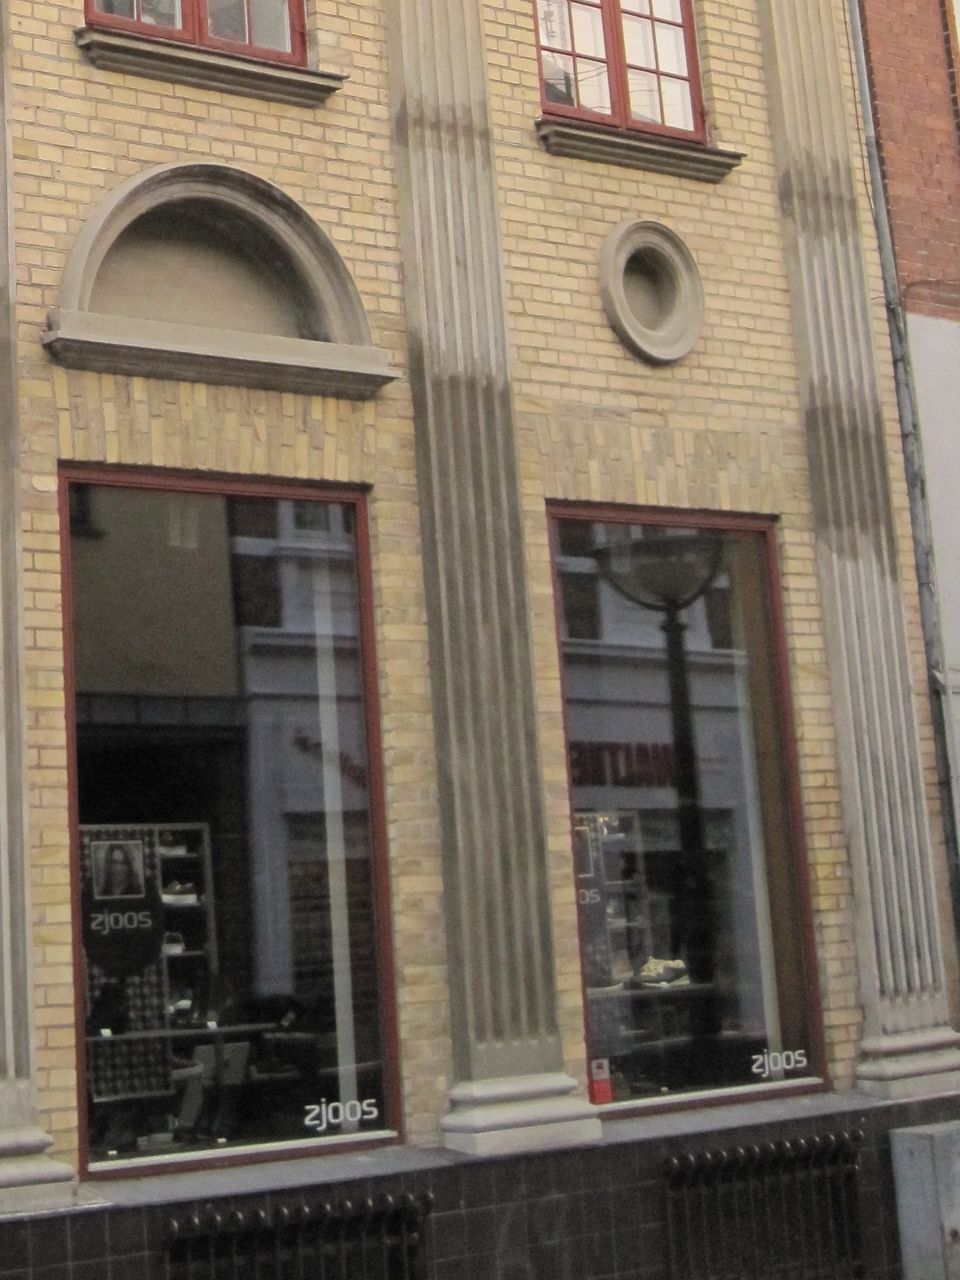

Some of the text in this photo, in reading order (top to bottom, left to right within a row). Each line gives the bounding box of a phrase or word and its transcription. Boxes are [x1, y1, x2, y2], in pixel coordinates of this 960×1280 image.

[90, 909, 152, 935] zjoos
[751, 1048, 808, 1078] zjoos
[304, 1097, 379, 1132] zjoos
